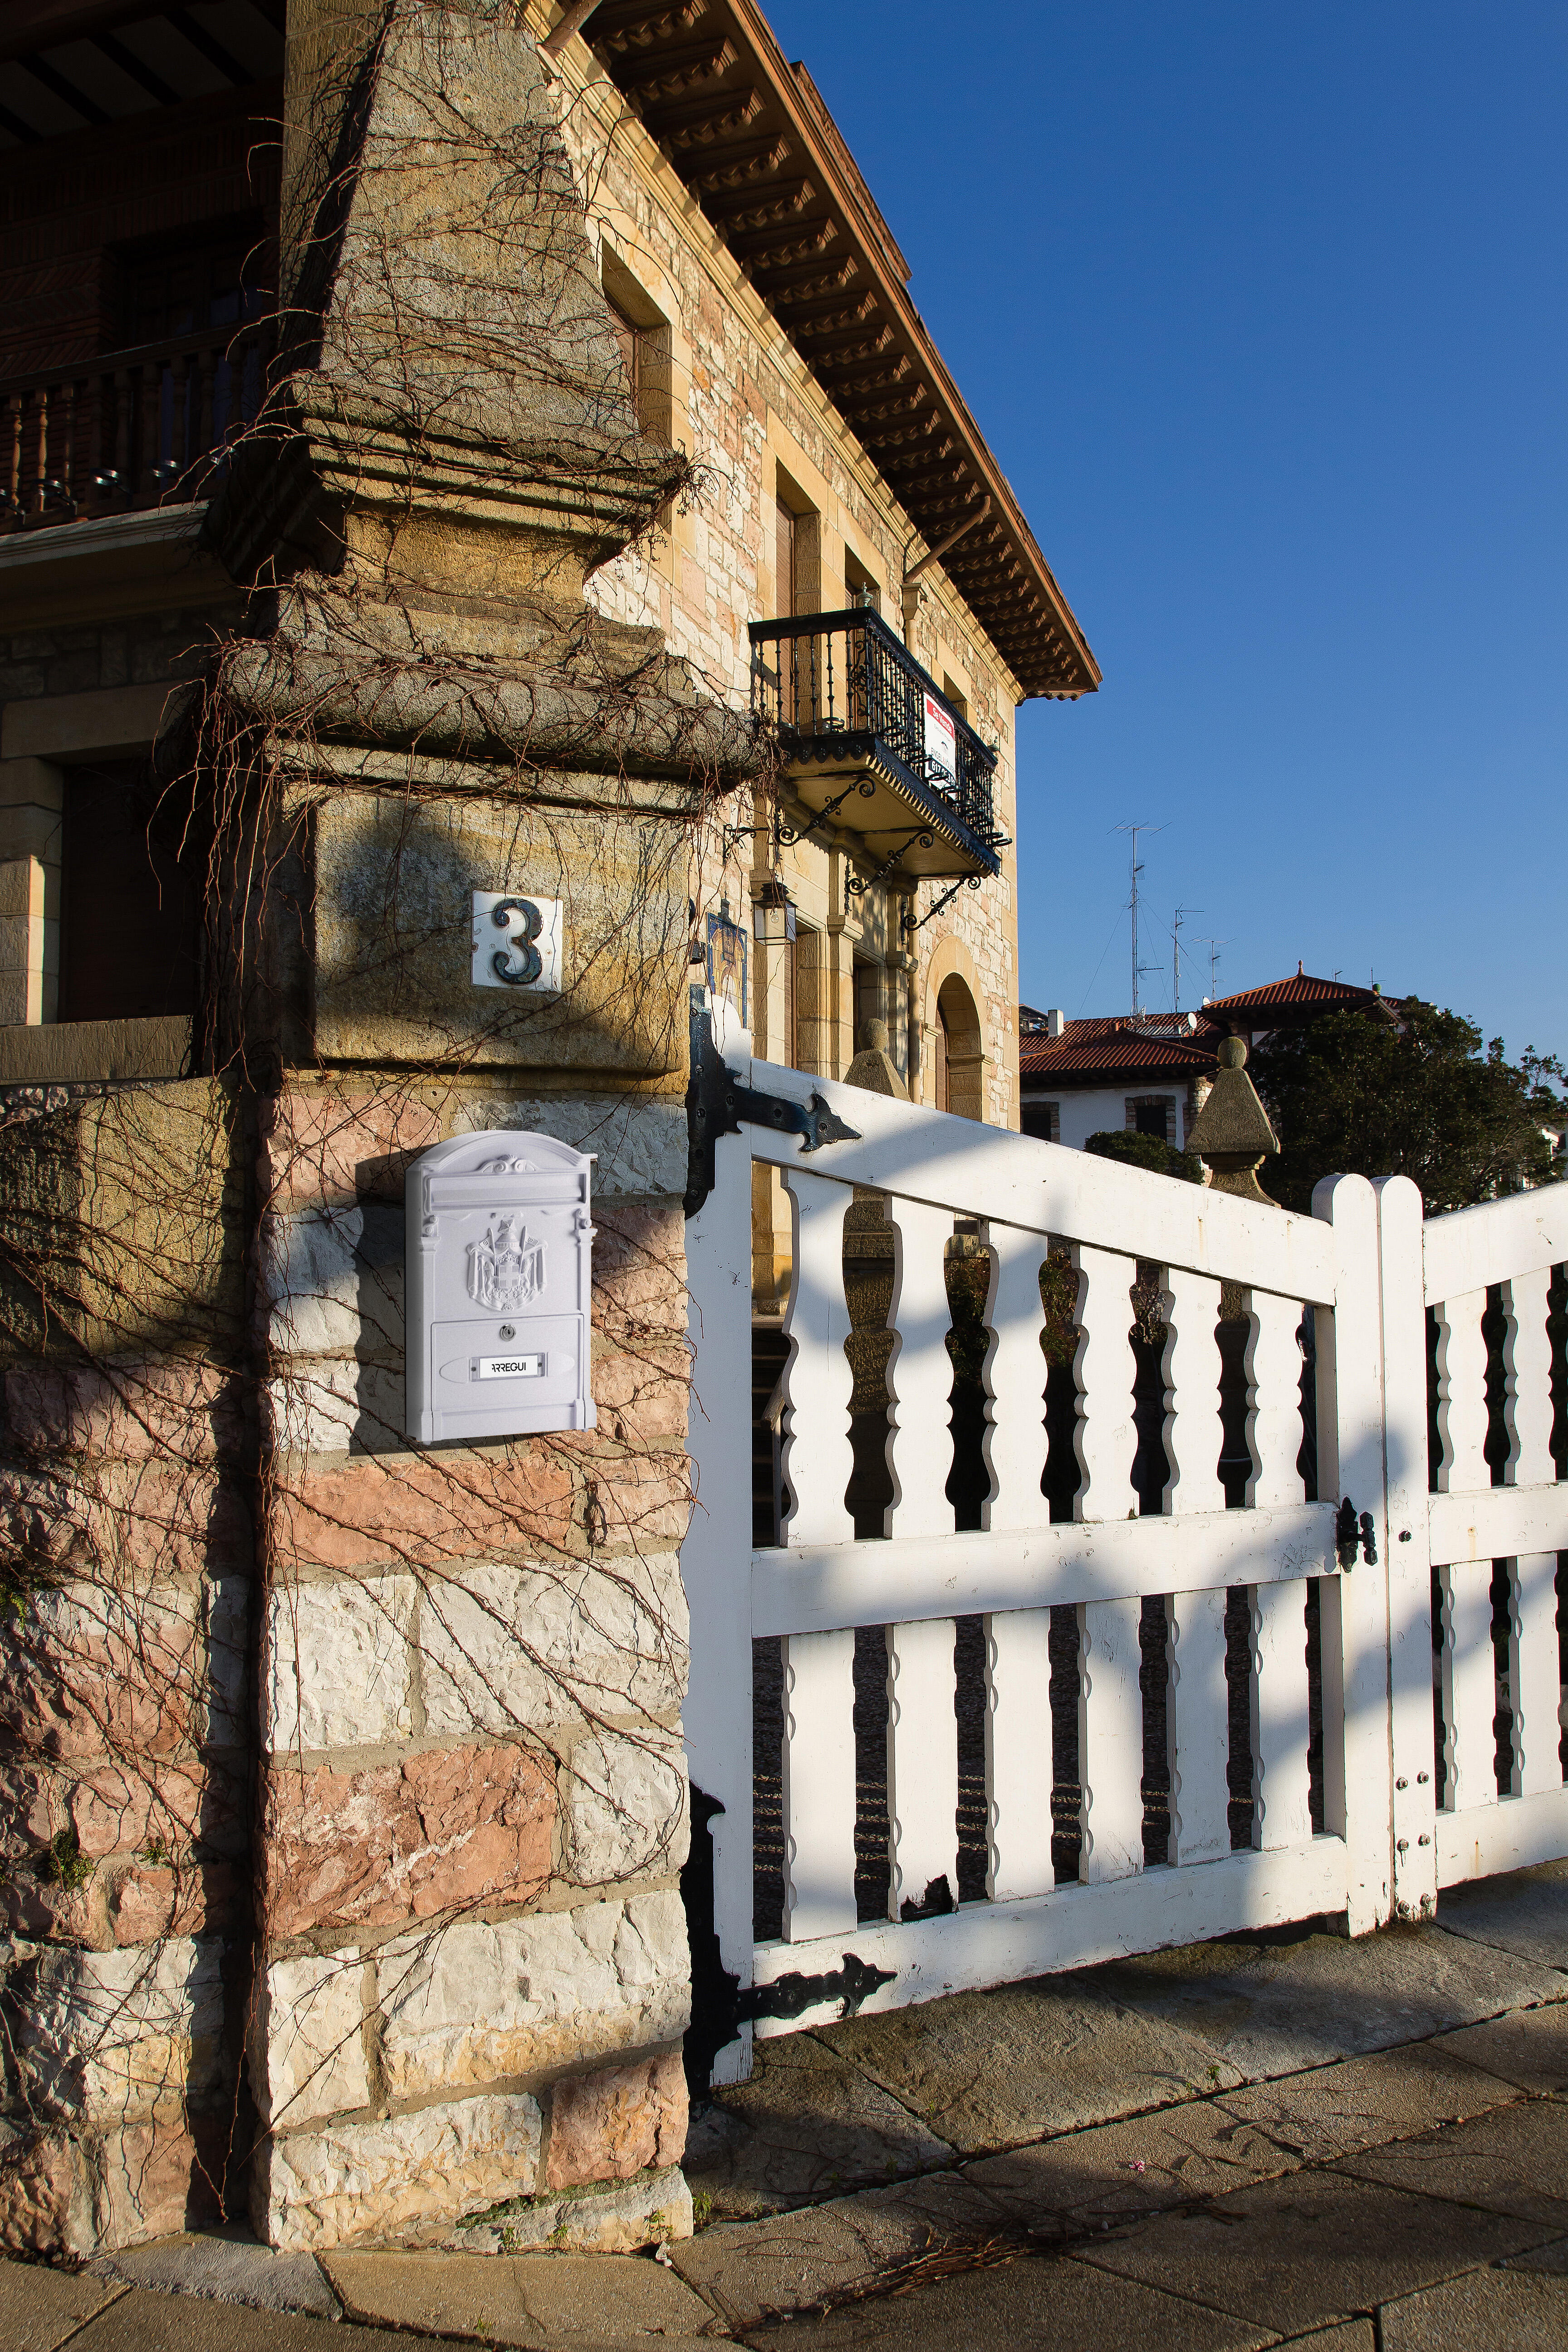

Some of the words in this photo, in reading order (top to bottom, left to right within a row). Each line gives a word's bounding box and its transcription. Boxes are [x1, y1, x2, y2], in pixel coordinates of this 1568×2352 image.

[932, 707, 939, 720] Se
[939, 713, 952, 734] Vende
[494, 898, 544, 985] 3
[491, 1362, 526, 1372] ARREGUI
